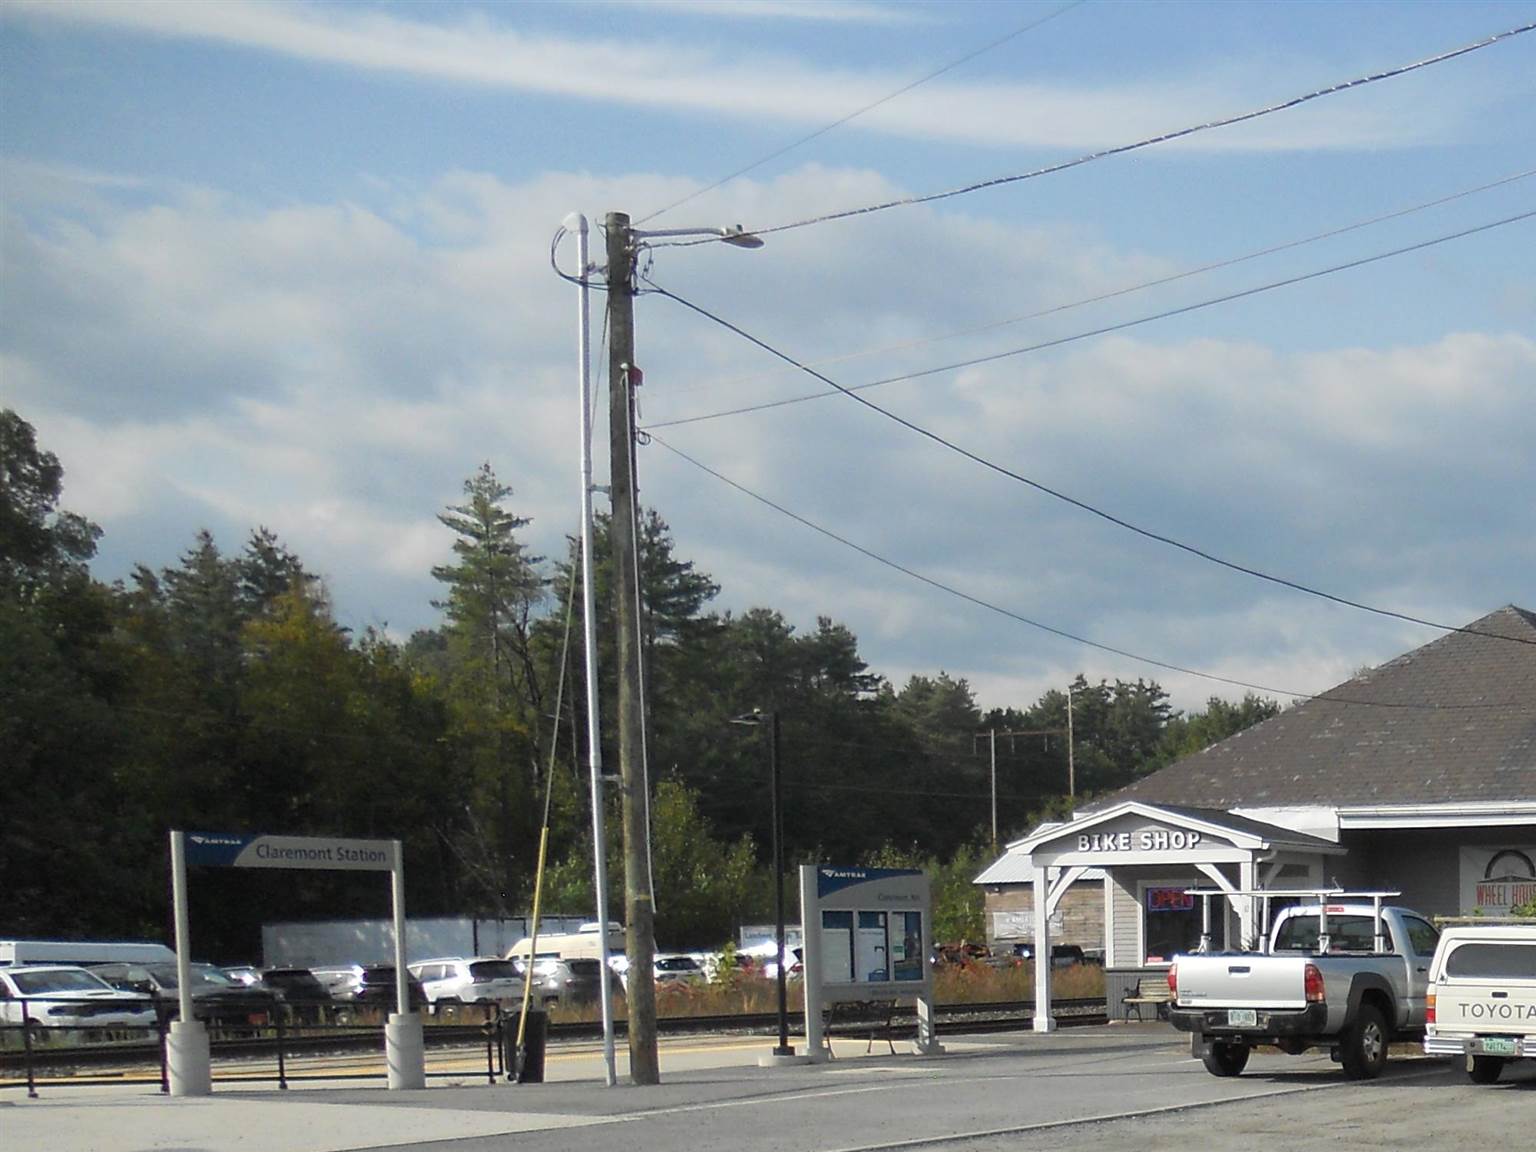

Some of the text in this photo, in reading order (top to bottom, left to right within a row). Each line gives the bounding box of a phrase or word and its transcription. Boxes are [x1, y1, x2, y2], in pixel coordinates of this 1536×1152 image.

[1078, 831, 1201, 852] BIKE SHOP
[256, 844, 387, 863] Claremont Station
[1476, 884, 1507, 906] WHEEL
